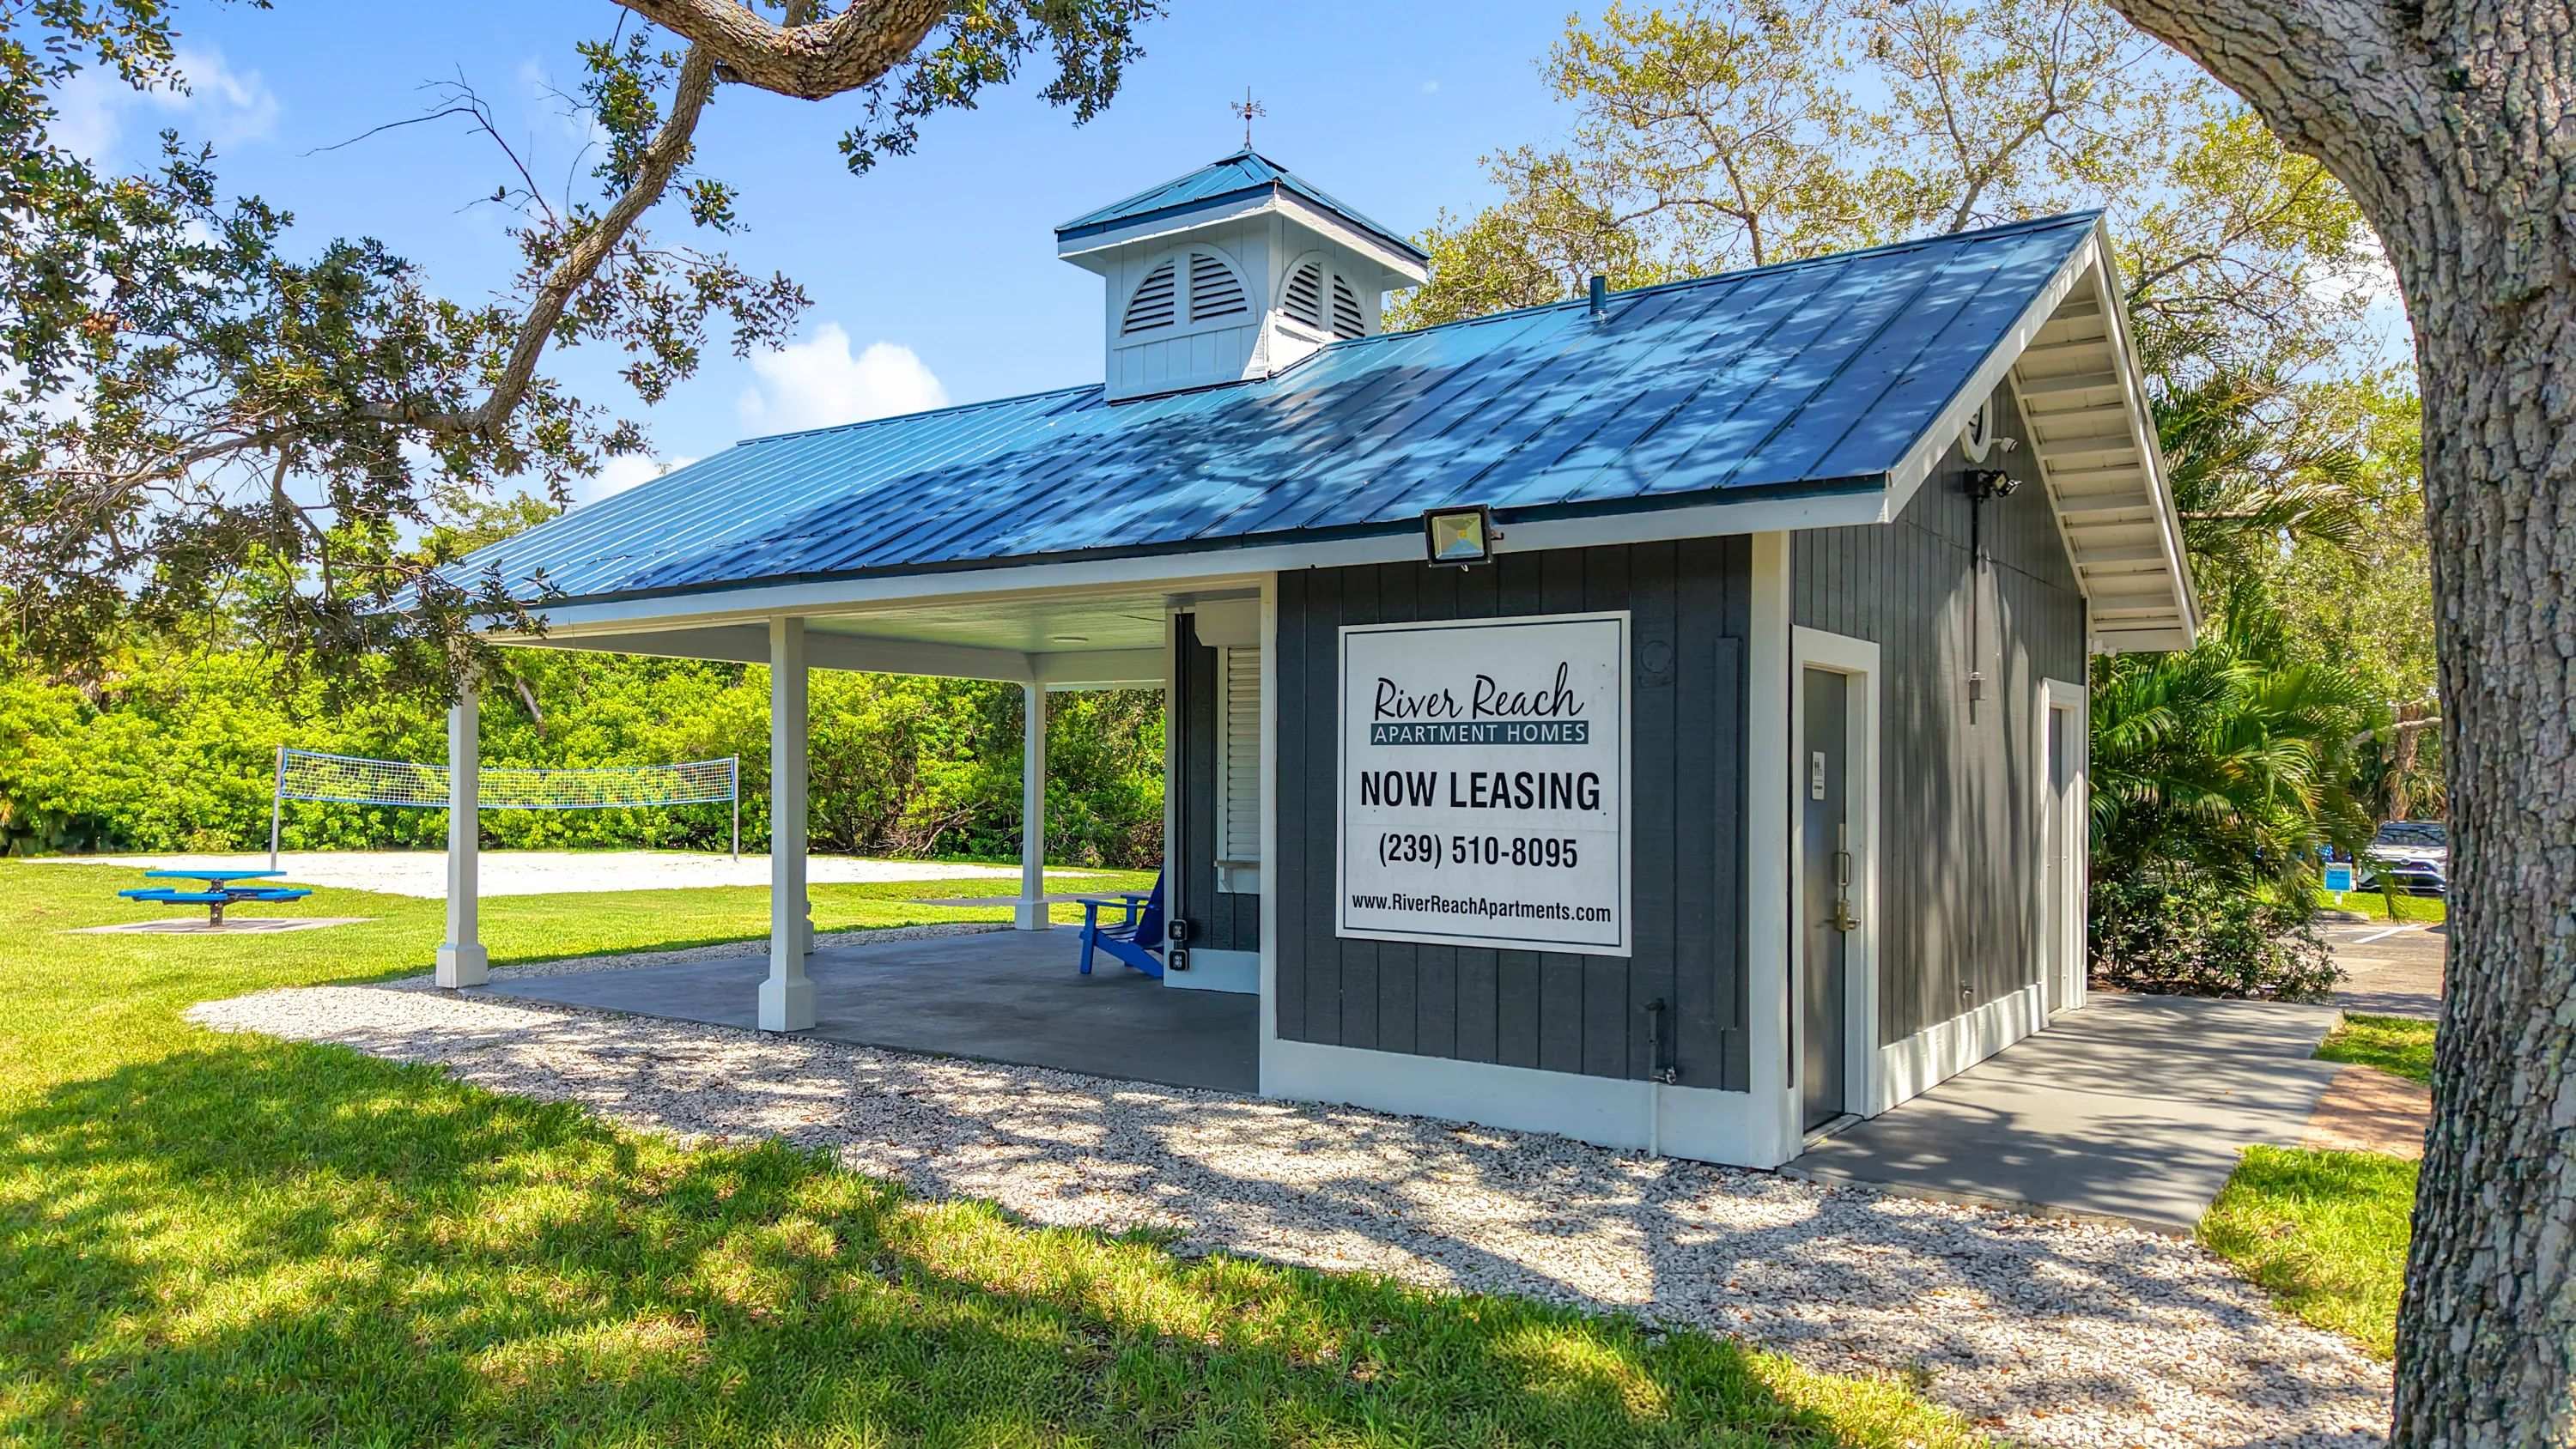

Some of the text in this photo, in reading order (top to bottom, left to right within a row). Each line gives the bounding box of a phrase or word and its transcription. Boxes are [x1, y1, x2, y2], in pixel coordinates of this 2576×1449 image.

[1374, 662, 1584, 721] River Reach
[1374, 724, 1585, 743] APARTMENT HOMES
[1361, 771, 1600, 809] NOW LEASING
[1379, 833, 1578, 869] (239) 510-8095
[1352, 894, 1611, 923] www.RiverReachApartments.com
